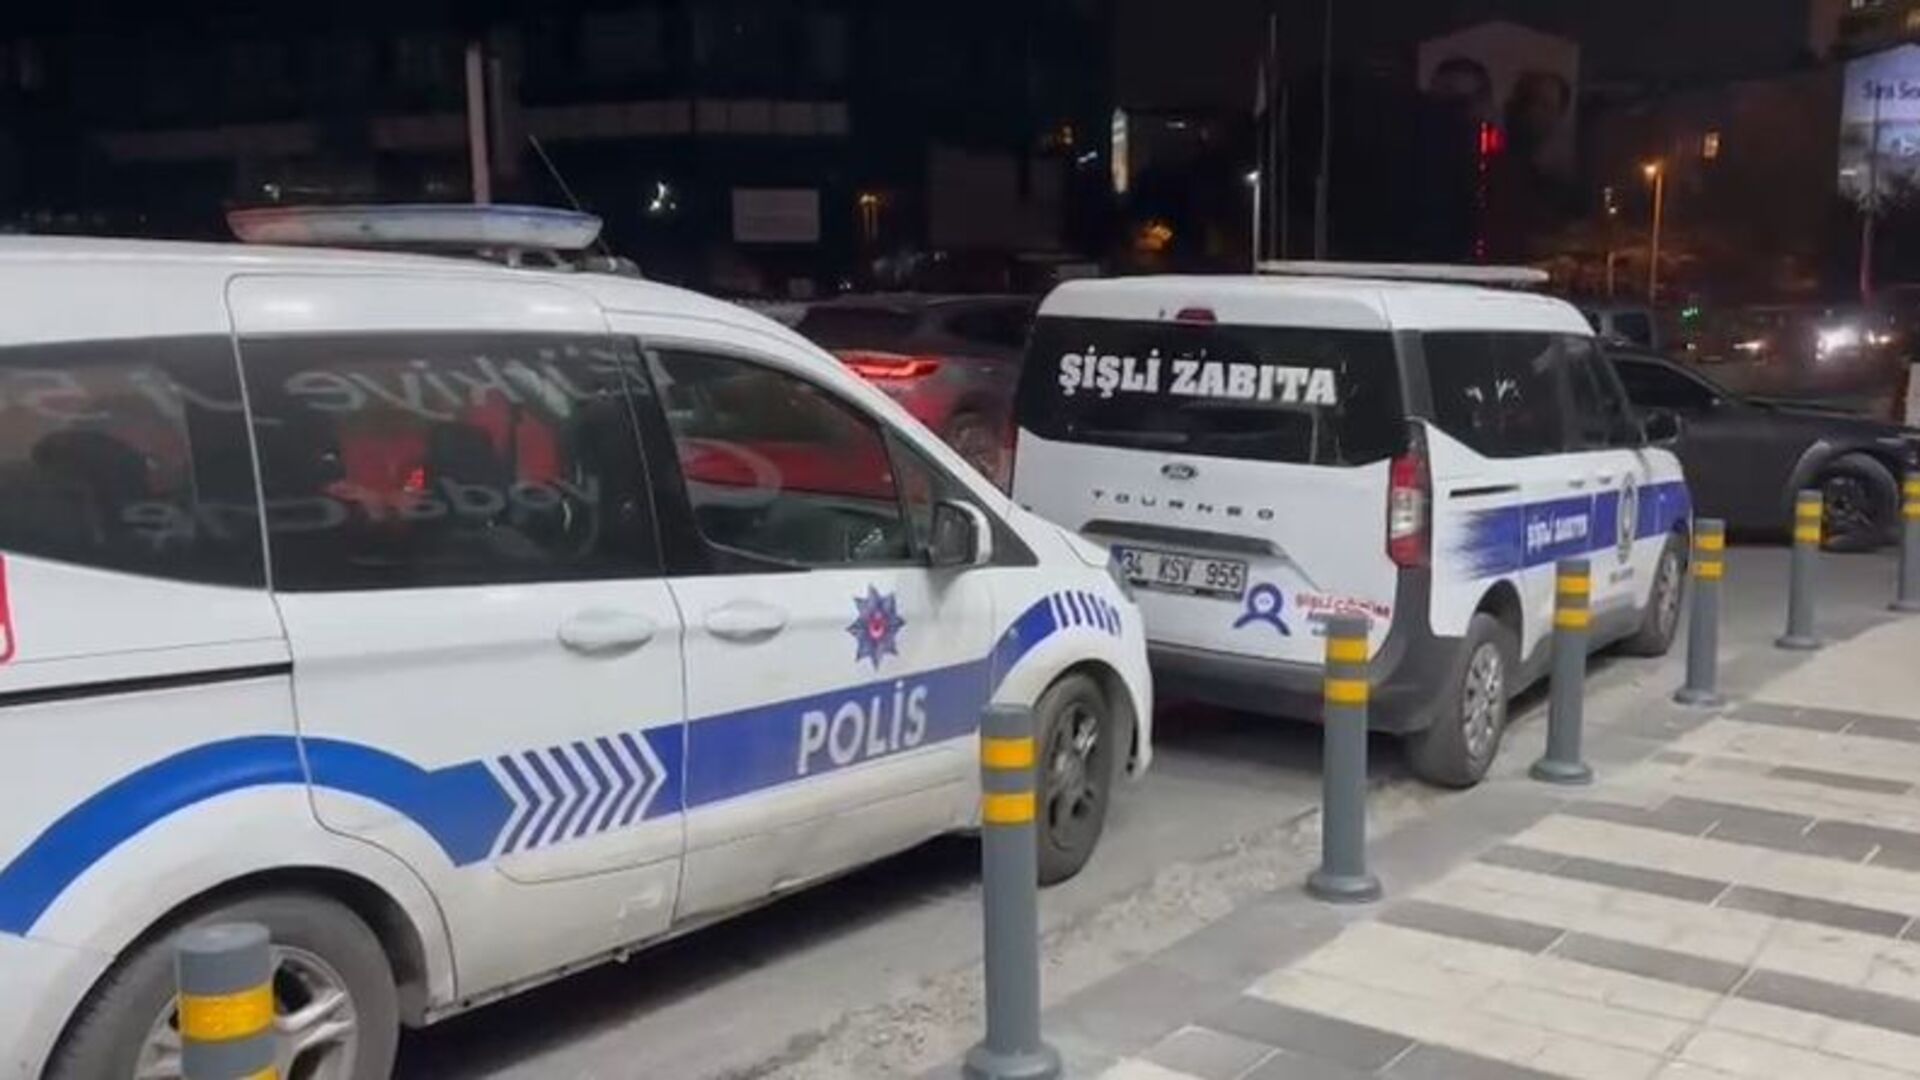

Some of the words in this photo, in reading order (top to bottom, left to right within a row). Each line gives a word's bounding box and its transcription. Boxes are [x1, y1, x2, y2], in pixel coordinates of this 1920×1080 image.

[1059, 345, 1161, 398] ŞİŞLİ
[1170, 359, 1337, 404] ZABITA
[1123, 551, 1142, 575] 34
[1158, 555, 1195, 582] KSV
[1205, 562, 1241, 589] 955
[797, 681, 928, 776] POLİS
